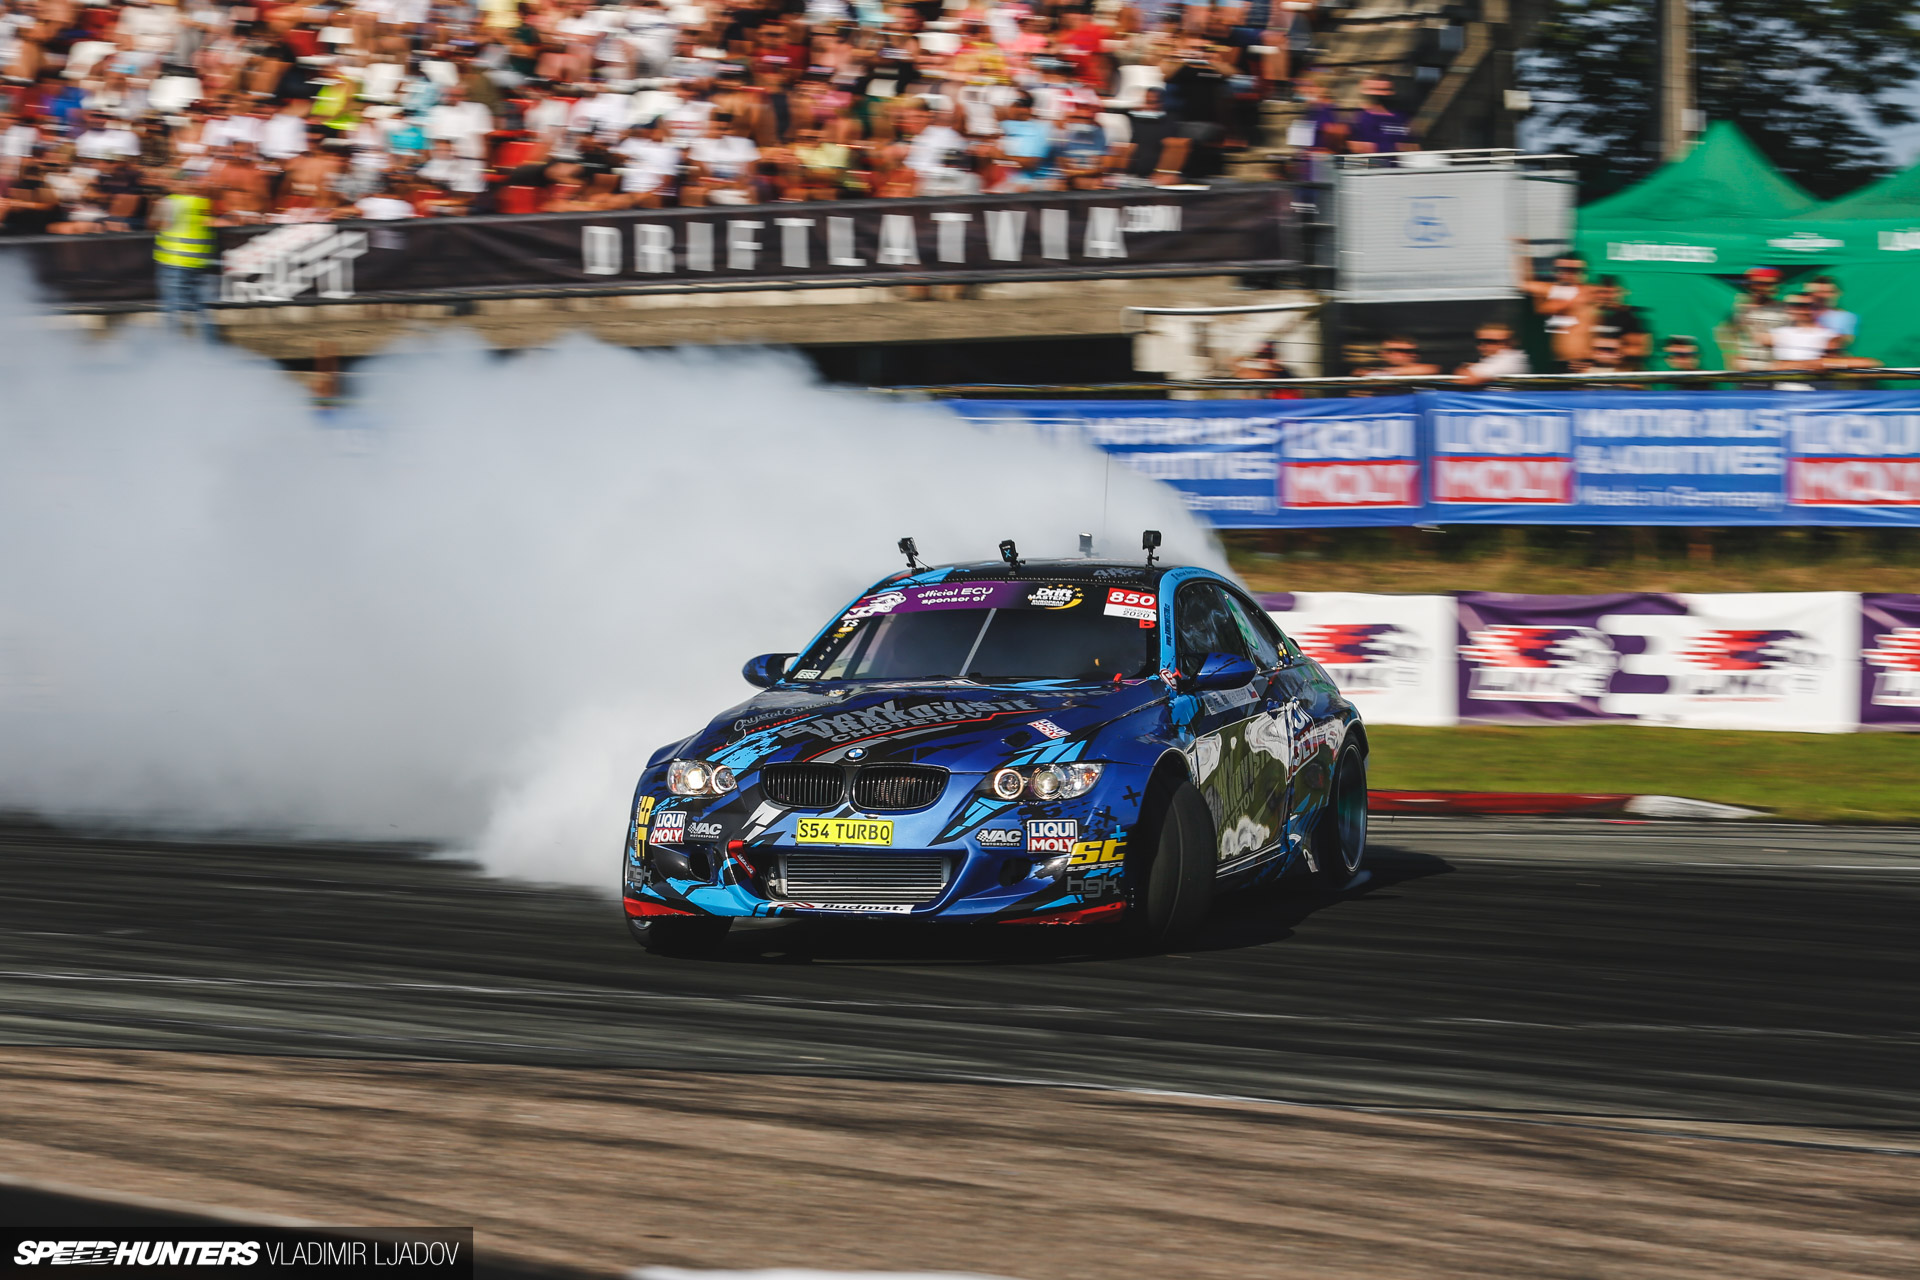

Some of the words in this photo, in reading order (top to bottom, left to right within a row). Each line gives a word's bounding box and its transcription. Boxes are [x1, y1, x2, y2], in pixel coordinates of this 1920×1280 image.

[1434, 414, 1571, 454] LIQUI
[1791, 415, 1920, 456] LIQU
[1434, 459, 1574, 499] MOLY
[917, 588, 959, 599] official
[961, 587, 994, 596] ECU
[921, 596, 970, 605] sponsor
[976, 594, 986, 602] of
[1036, 587, 1074, 600] Drift
[1109, 592, 1155, 606] 850
[1122, 610, 1150, 619] 2020
[656, 813, 684, 828] LIQUI
[690, 822, 722, 835] VAC
[799, 823, 829, 839] S54
[836, 823, 890, 840] TURBO
[1031, 822, 1075, 837] LIQUI
[652, 829, 683, 843] MOLY
[979, 829, 1022, 843] VAC
[1031, 838, 1076, 853] MOLY
[1066, 875, 1118, 899] hgk
